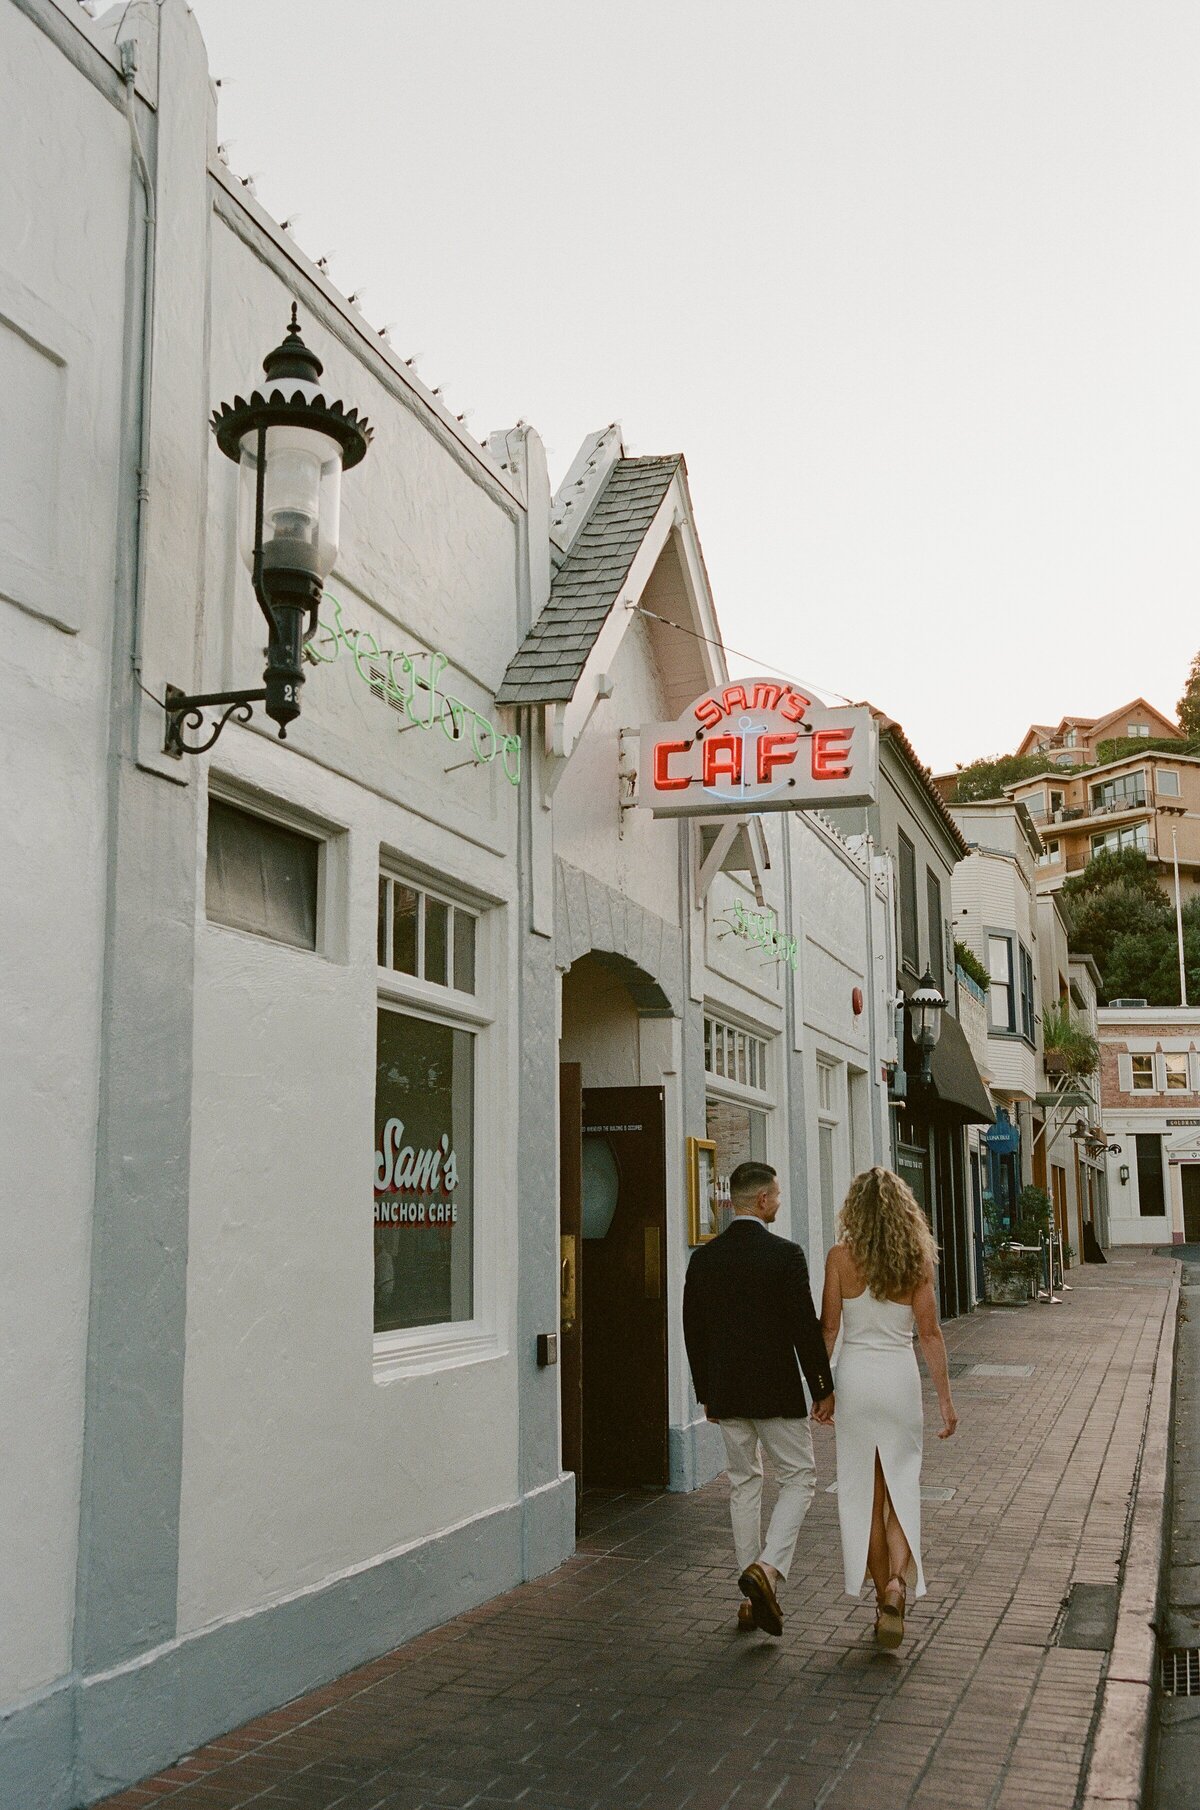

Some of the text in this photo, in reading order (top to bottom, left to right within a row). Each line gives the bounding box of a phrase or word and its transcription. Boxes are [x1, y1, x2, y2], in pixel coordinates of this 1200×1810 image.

[695, 683, 812, 730] SAM'S
[654, 727, 855, 790] CAFE
[374, 1117, 459, 1193] Sam's
[374, 1202, 458, 1222] ANCHOR CAFE
